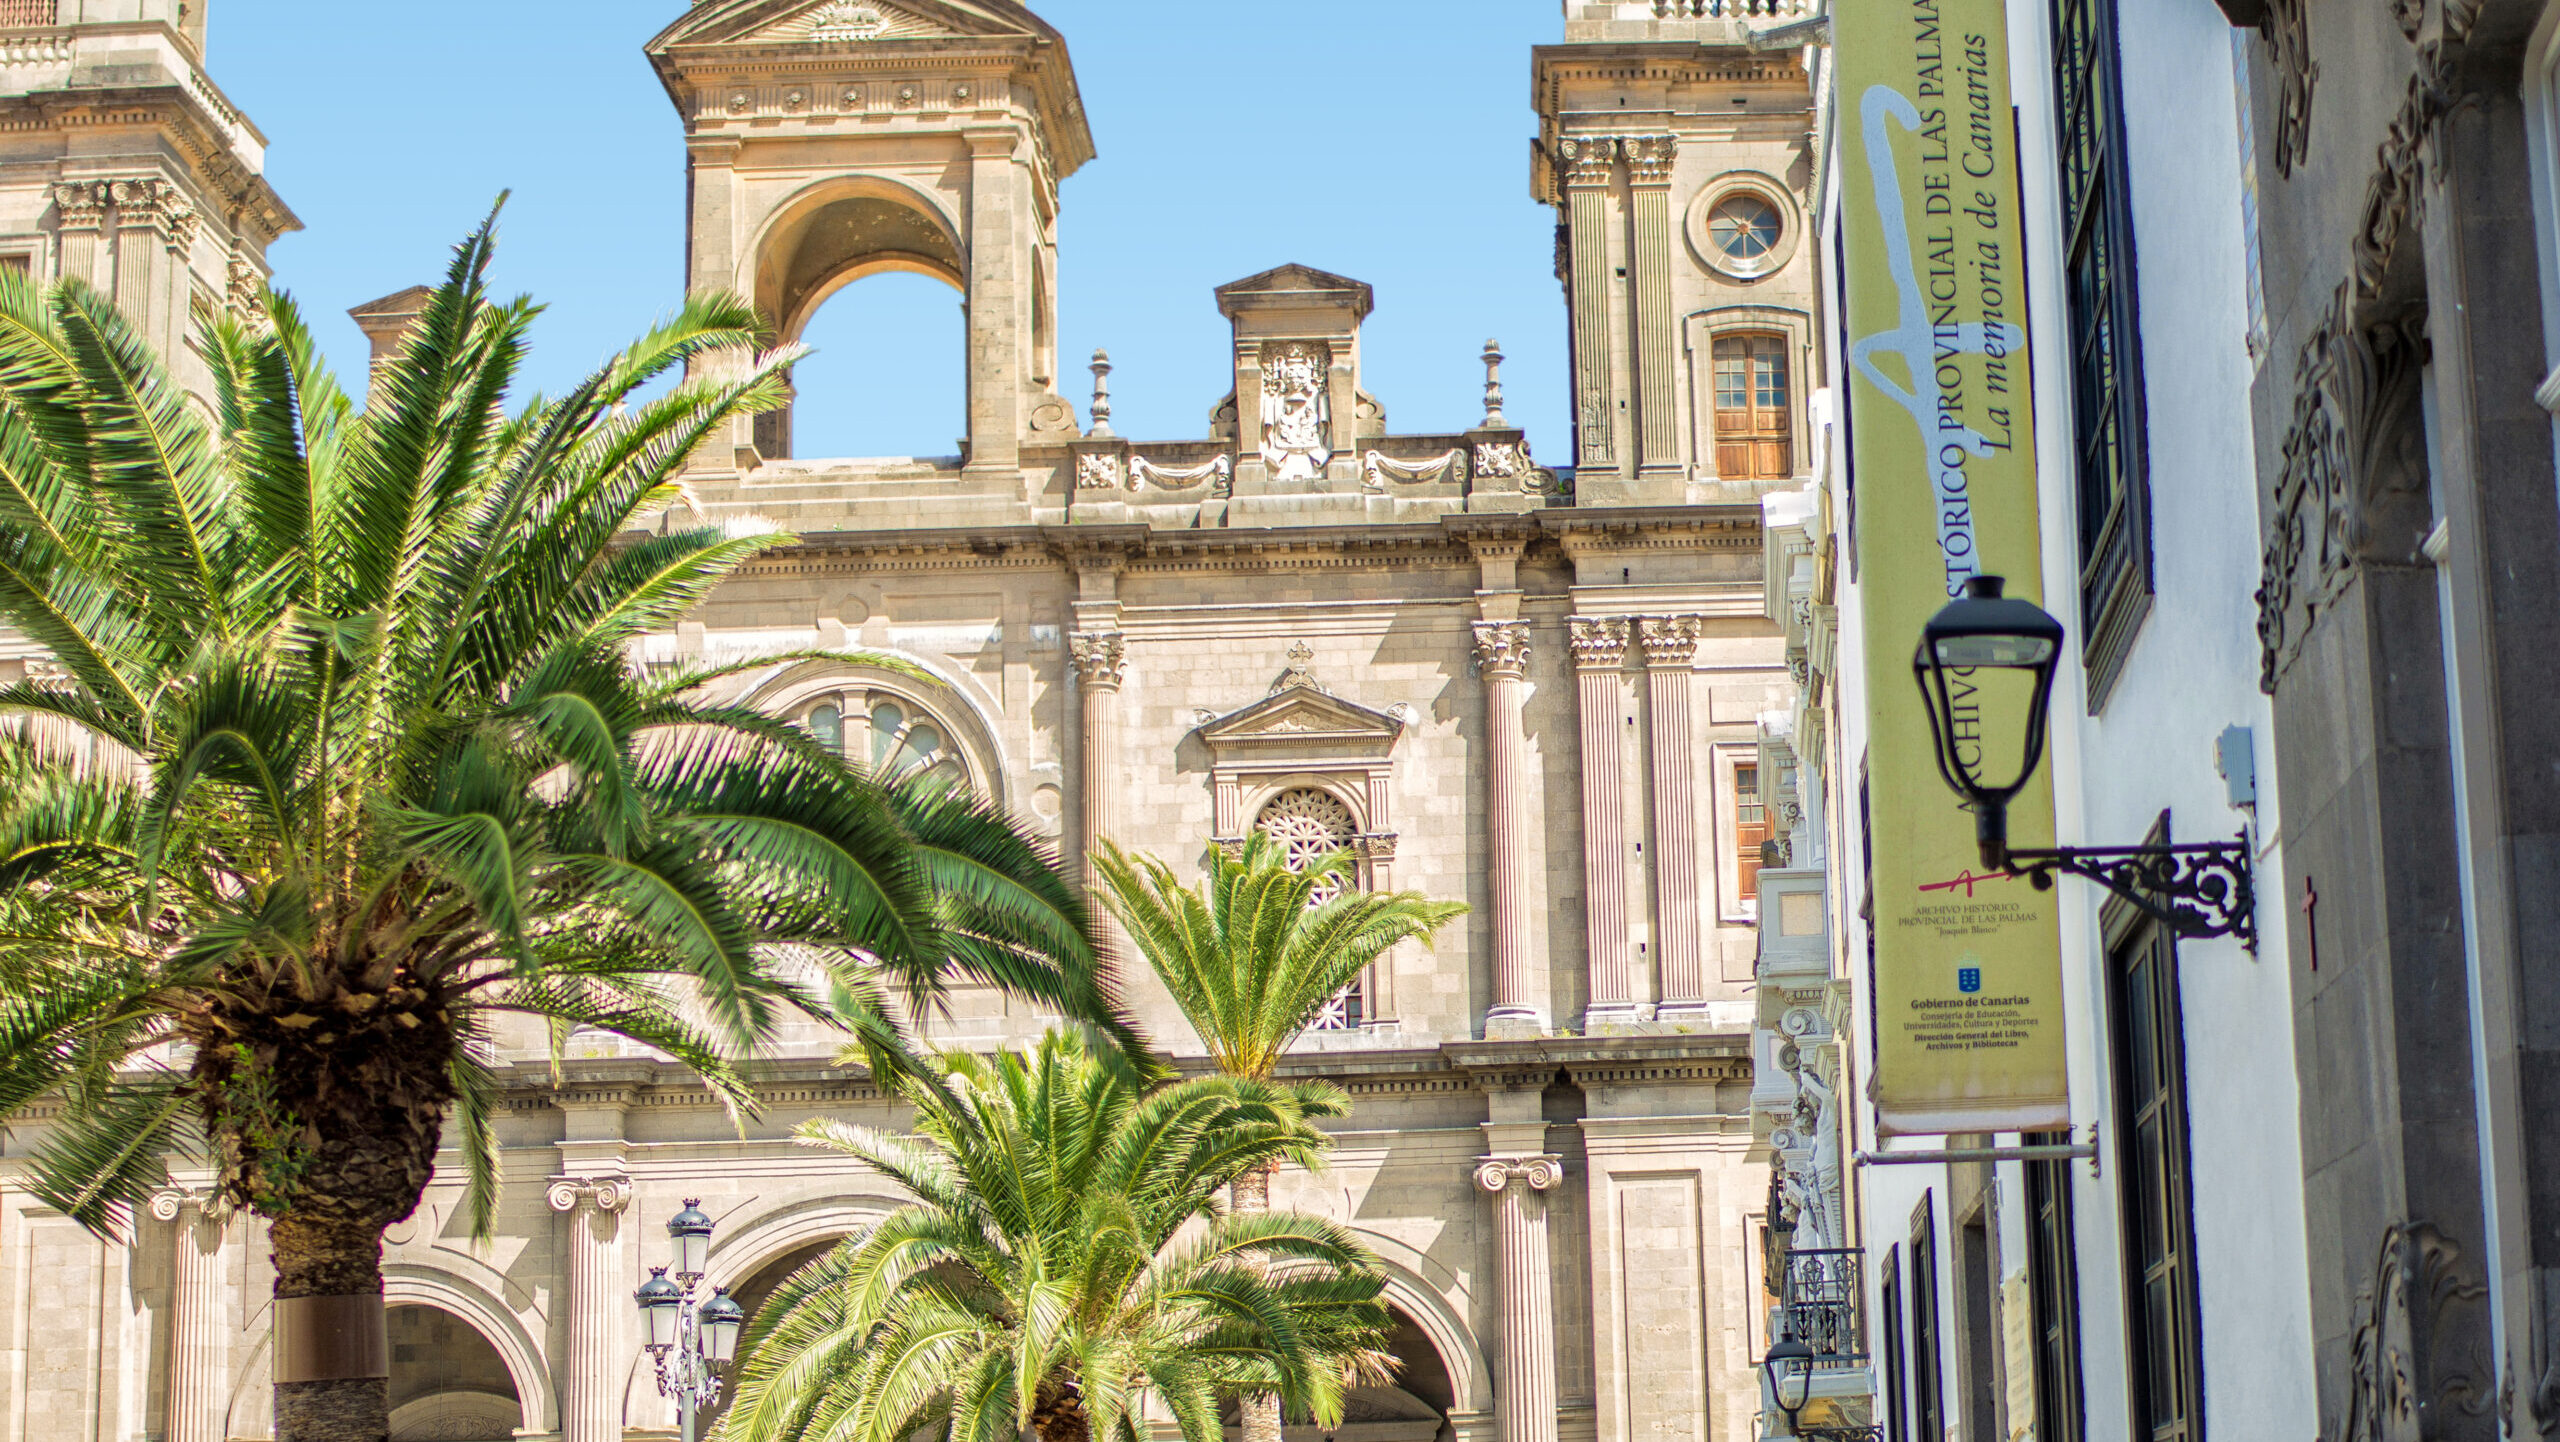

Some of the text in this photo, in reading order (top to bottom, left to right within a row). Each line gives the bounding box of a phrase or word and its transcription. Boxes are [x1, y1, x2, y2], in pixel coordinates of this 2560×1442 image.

[1919, 108, 1949, 164] LAS
[1924, 173, 1952, 217] DE
[1957, 33, 2012, 453] La memoria de Canarias
[1928, 227, 1964, 432] PROVINCIAL
[1936, 443, 1973, 598] STÓRICO
[1915, 905, 1961, 915] ARCHIVO
[1899, 911, 2037, 927] PROVINCIAL DE LAS PALMAS
[1911, 995, 2030, 1010] Gobierno de Canarias
[1964, 1010, 1975, 1019] de
[1963, 1019, 1994, 1028] Cultura
[2002, 1017, 2039, 1027] Deportes
[1956, 1030, 1988, 1040] General
[1990, 1029, 2003, 1038] del
[2005, 1028, 2030, 1038] Libro,
[1925, 1039, 1963, 1051] Archivos
[1972, 1037, 2019, 1048] Bibliotecas
